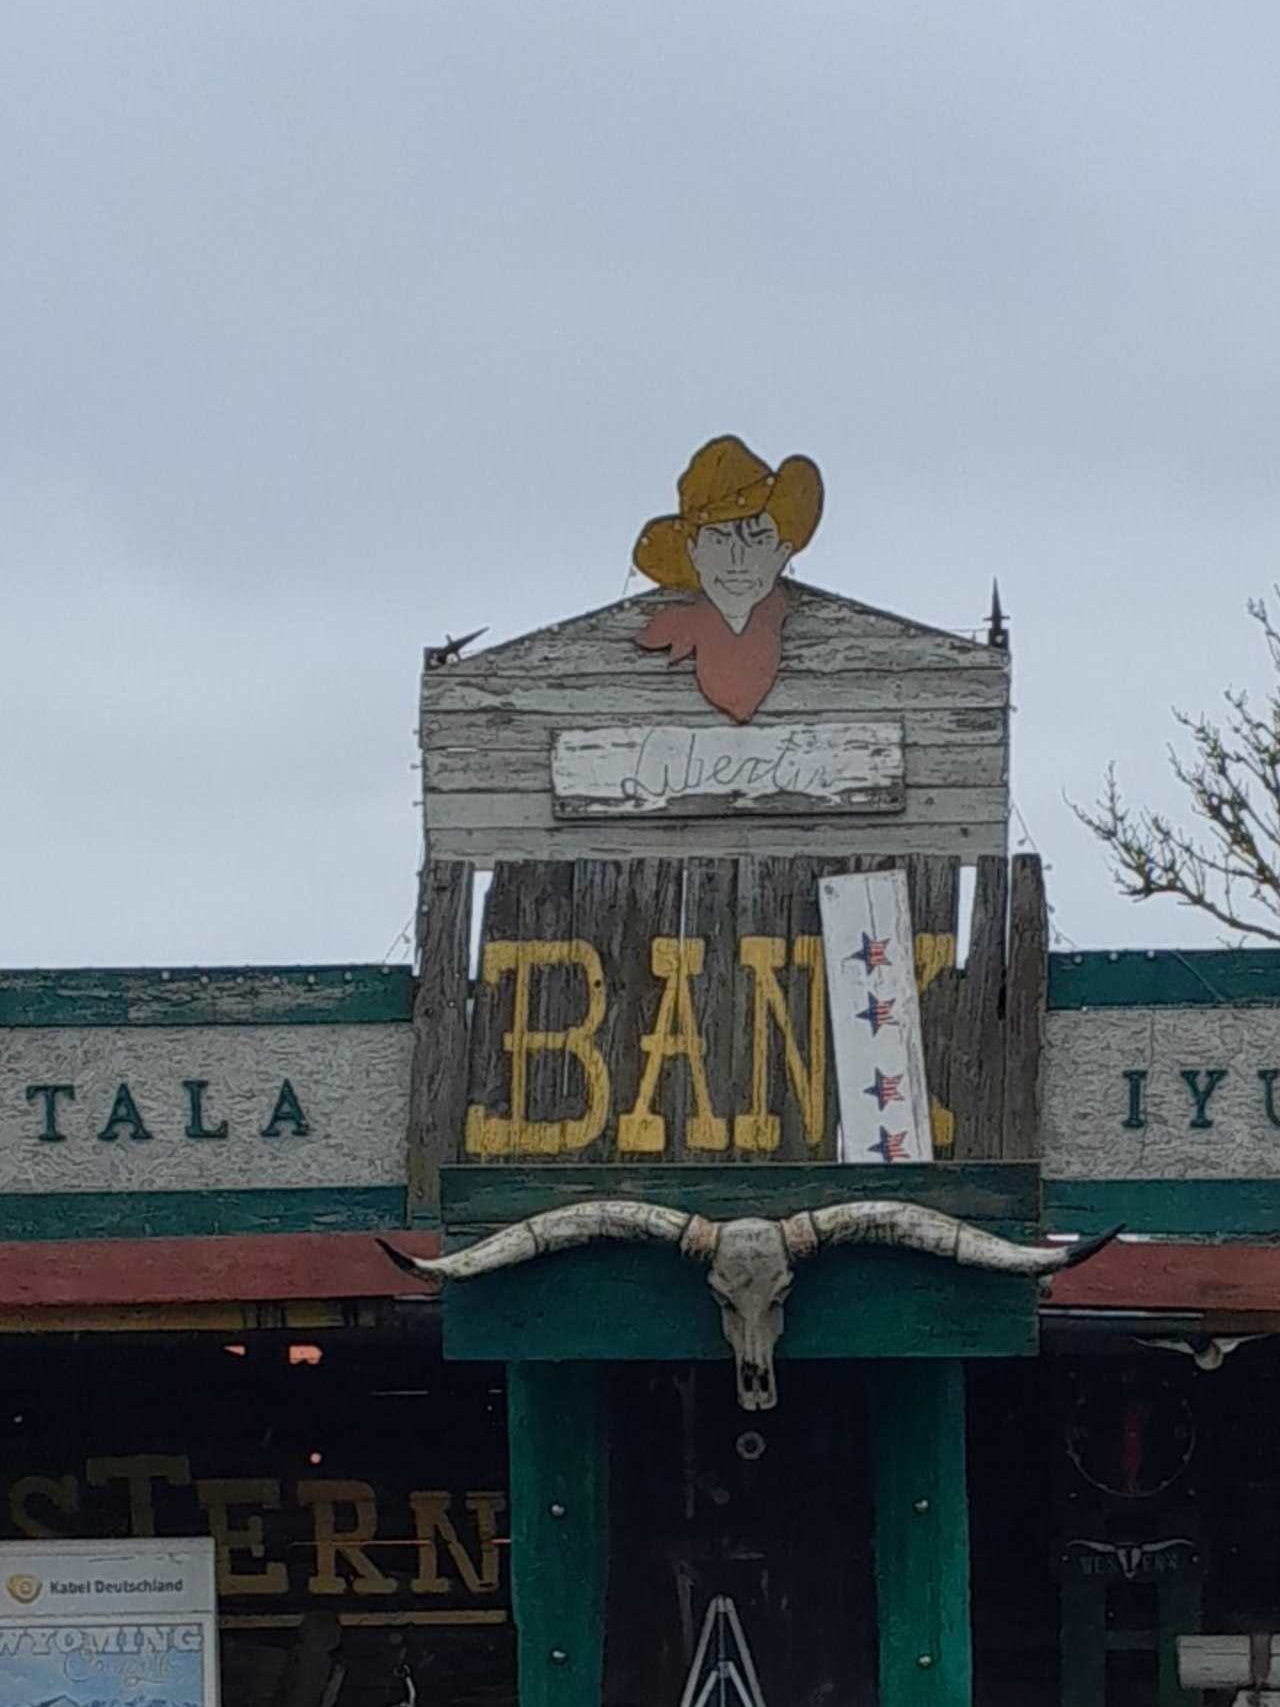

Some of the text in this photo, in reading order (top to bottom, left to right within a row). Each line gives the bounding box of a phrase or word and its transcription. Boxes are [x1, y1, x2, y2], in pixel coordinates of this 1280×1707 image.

[464, 934, 956, 1155] BAN
[49, 1578, 184, 1594] Kabel Deutschland
